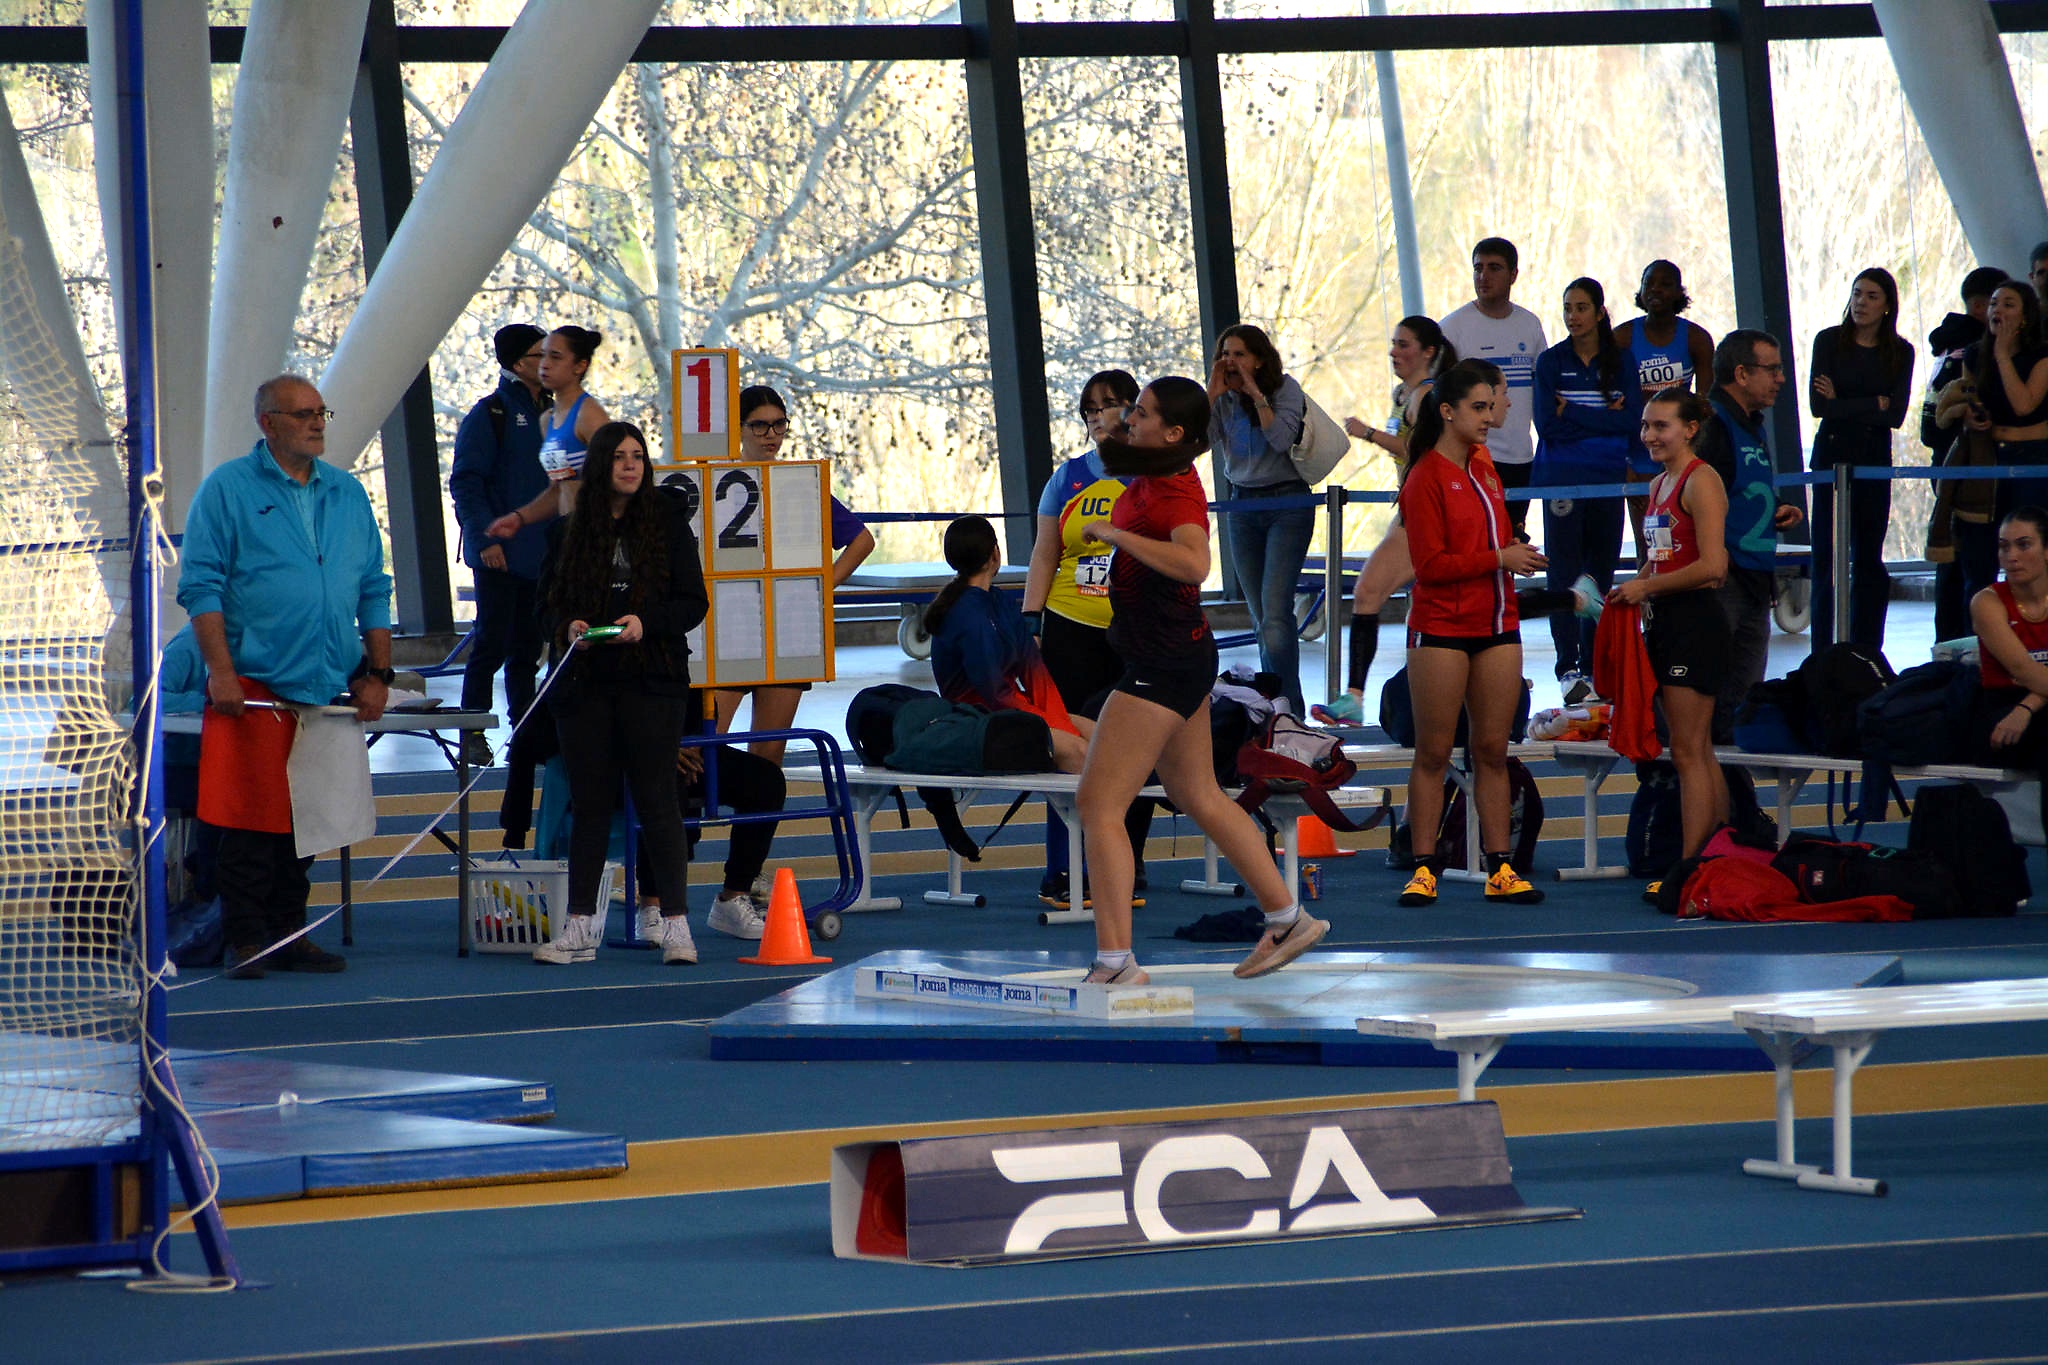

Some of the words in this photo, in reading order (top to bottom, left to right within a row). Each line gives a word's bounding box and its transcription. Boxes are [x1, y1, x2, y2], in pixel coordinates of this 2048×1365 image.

[687, 358, 711, 433] 1
[1639, 366, 1674, 384] 100
[715, 470, 760, 549] 2
[1081, 498, 1111, 516] UC
[1739, 481, 1777, 552] 2
[920, 979, 947, 993] Joma
[1004, 988, 1031, 1001] Joma
[992, 1126, 1437, 1254] FCA
